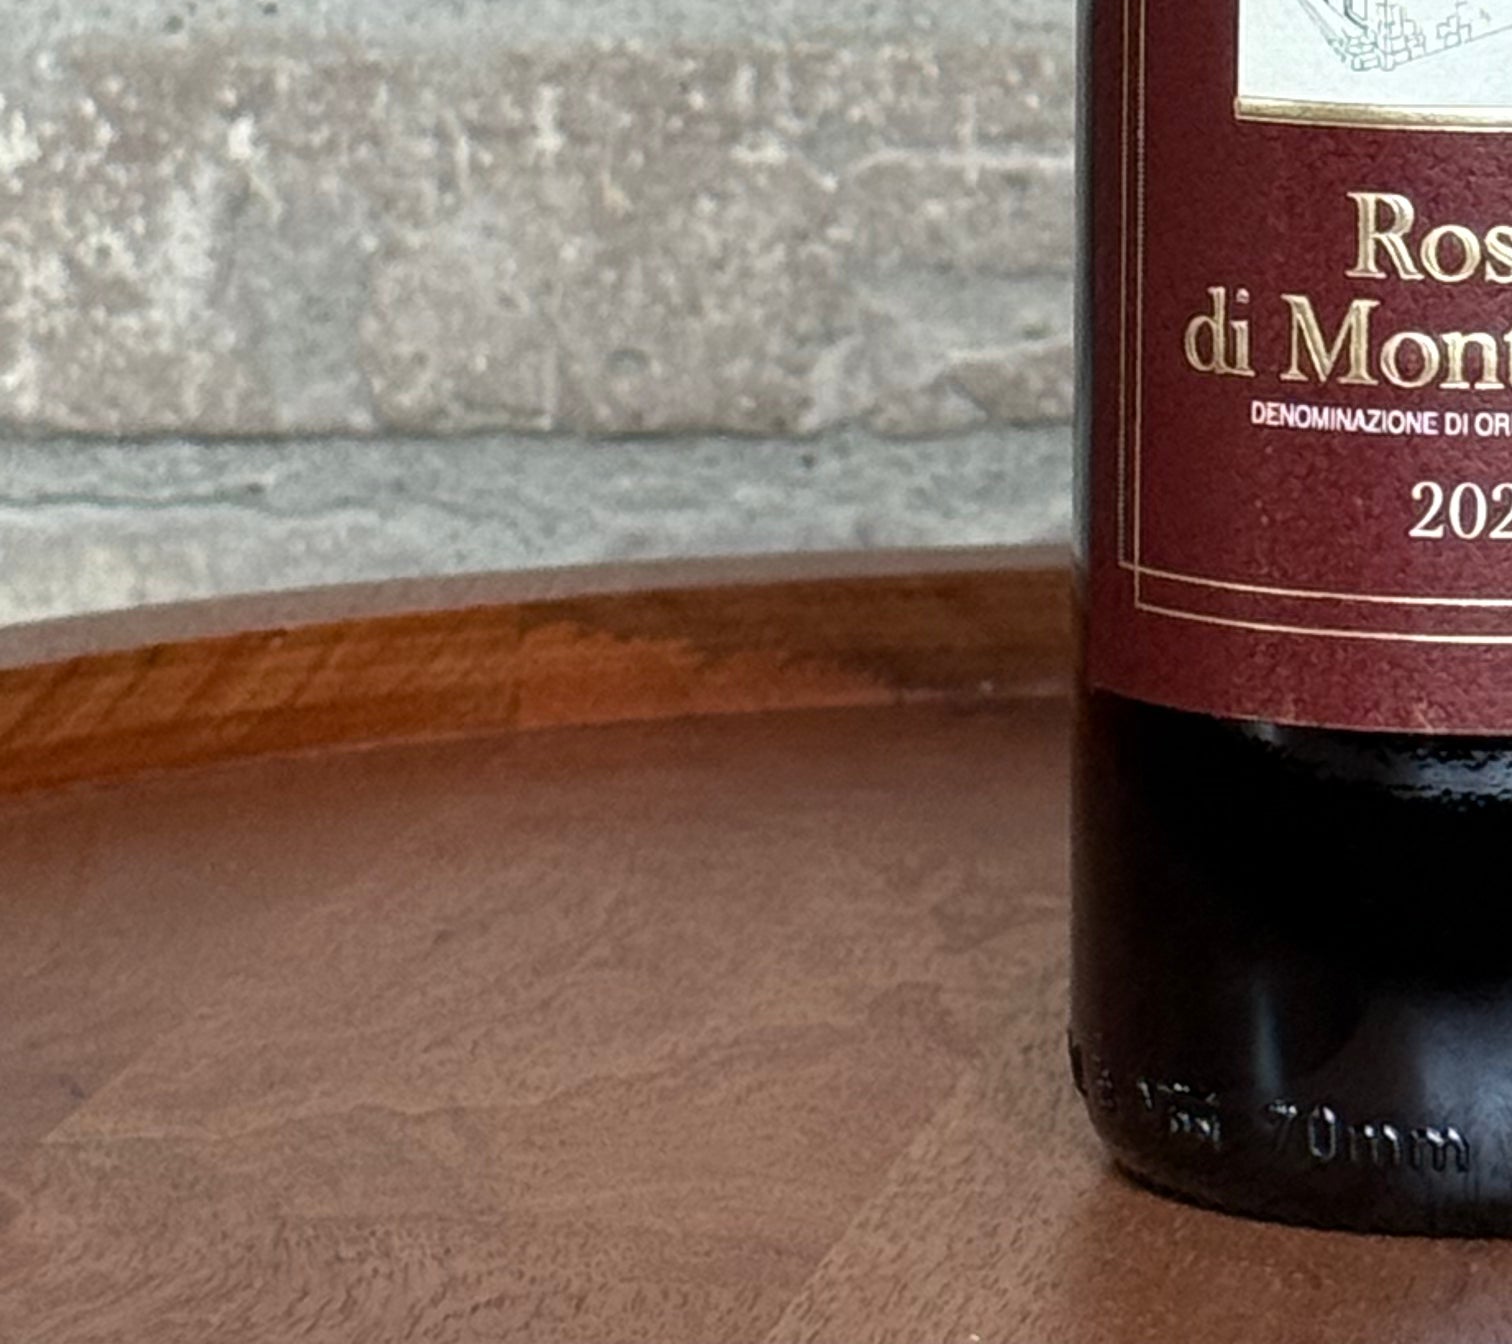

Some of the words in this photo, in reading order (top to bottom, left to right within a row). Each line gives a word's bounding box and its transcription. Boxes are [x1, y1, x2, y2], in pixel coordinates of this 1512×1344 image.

[1183, 285, 1256, 378] di
[1250, 400, 1439, 437] DENOMINAZIONE
[1444, 413, 1470, 437] DI
